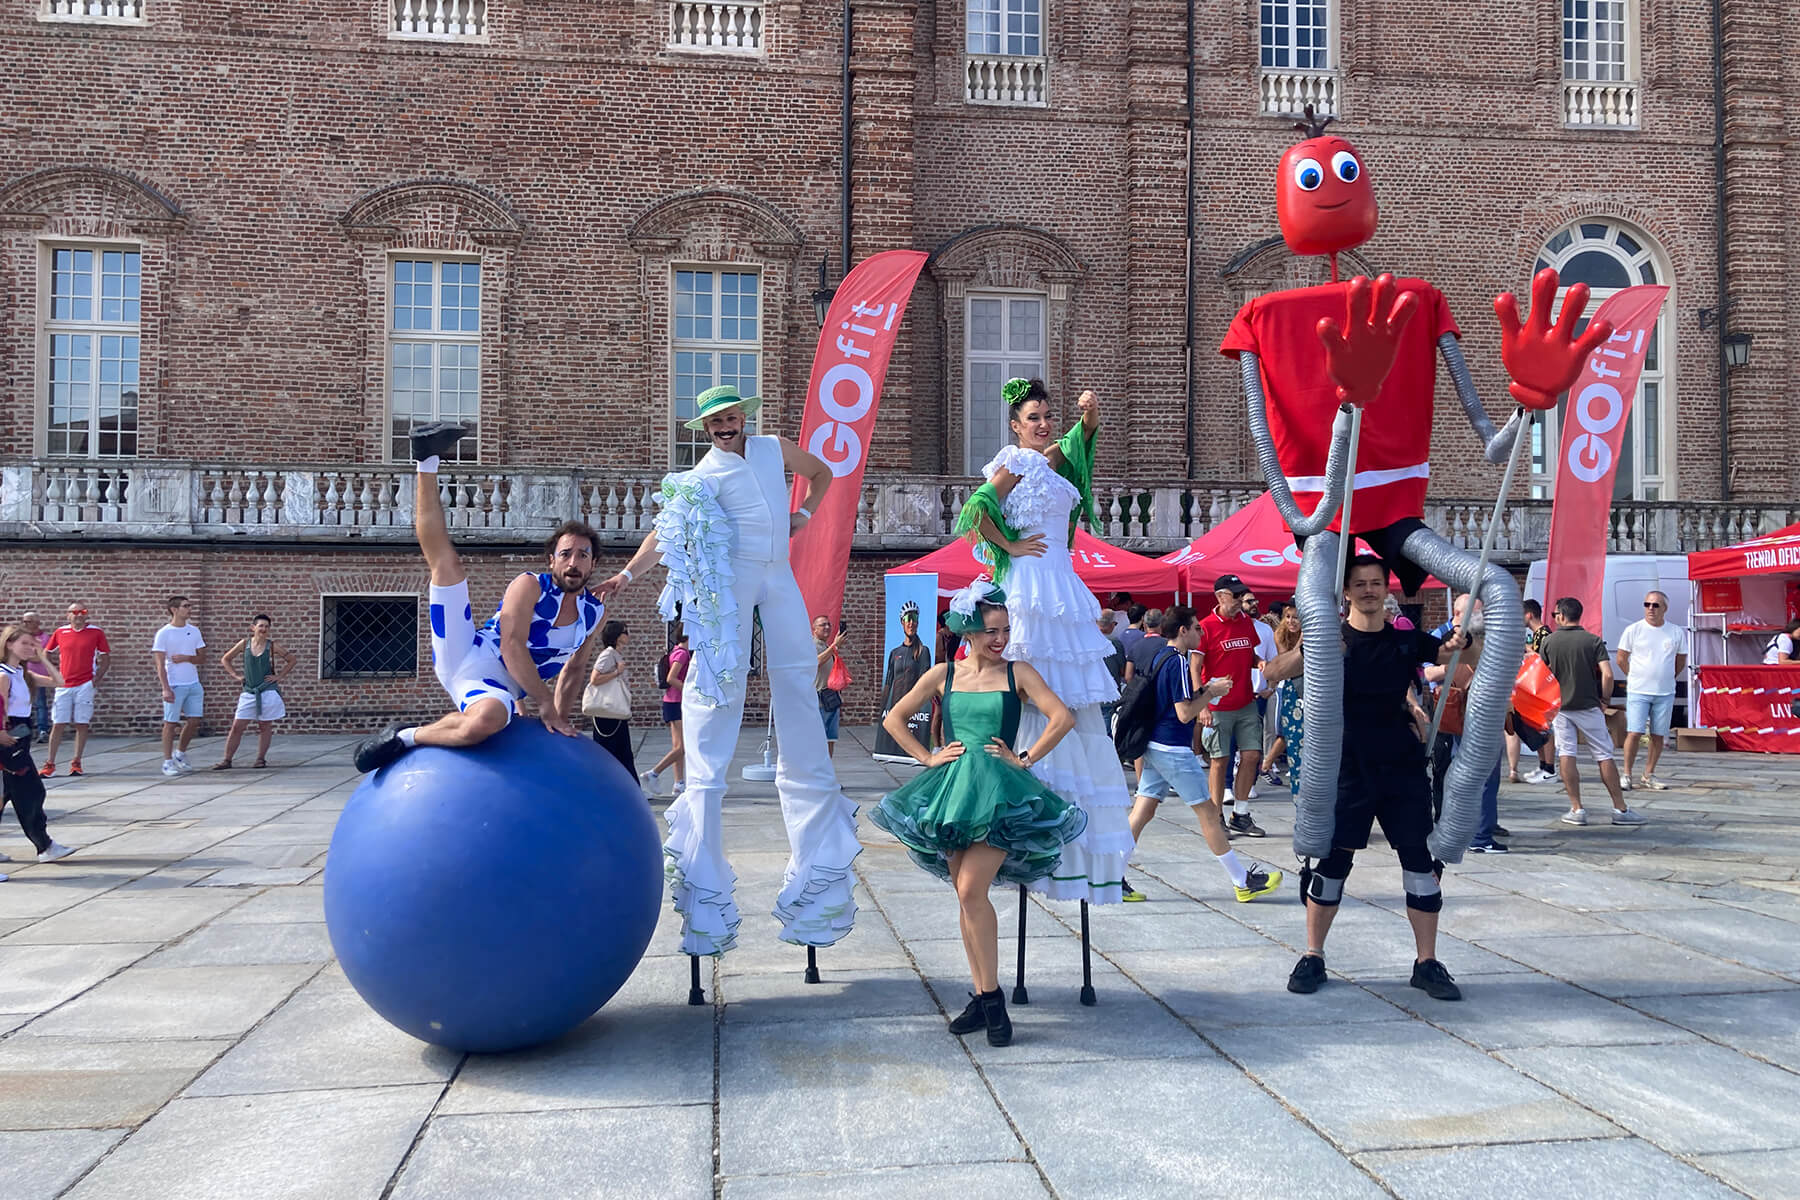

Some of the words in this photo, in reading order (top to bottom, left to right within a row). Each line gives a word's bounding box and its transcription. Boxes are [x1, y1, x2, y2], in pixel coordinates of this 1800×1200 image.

[809, 300, 890, 478] GOfit
[1744, 549, 1777, 568] TIENDA
[1770, 703, 1785, 718] LA
